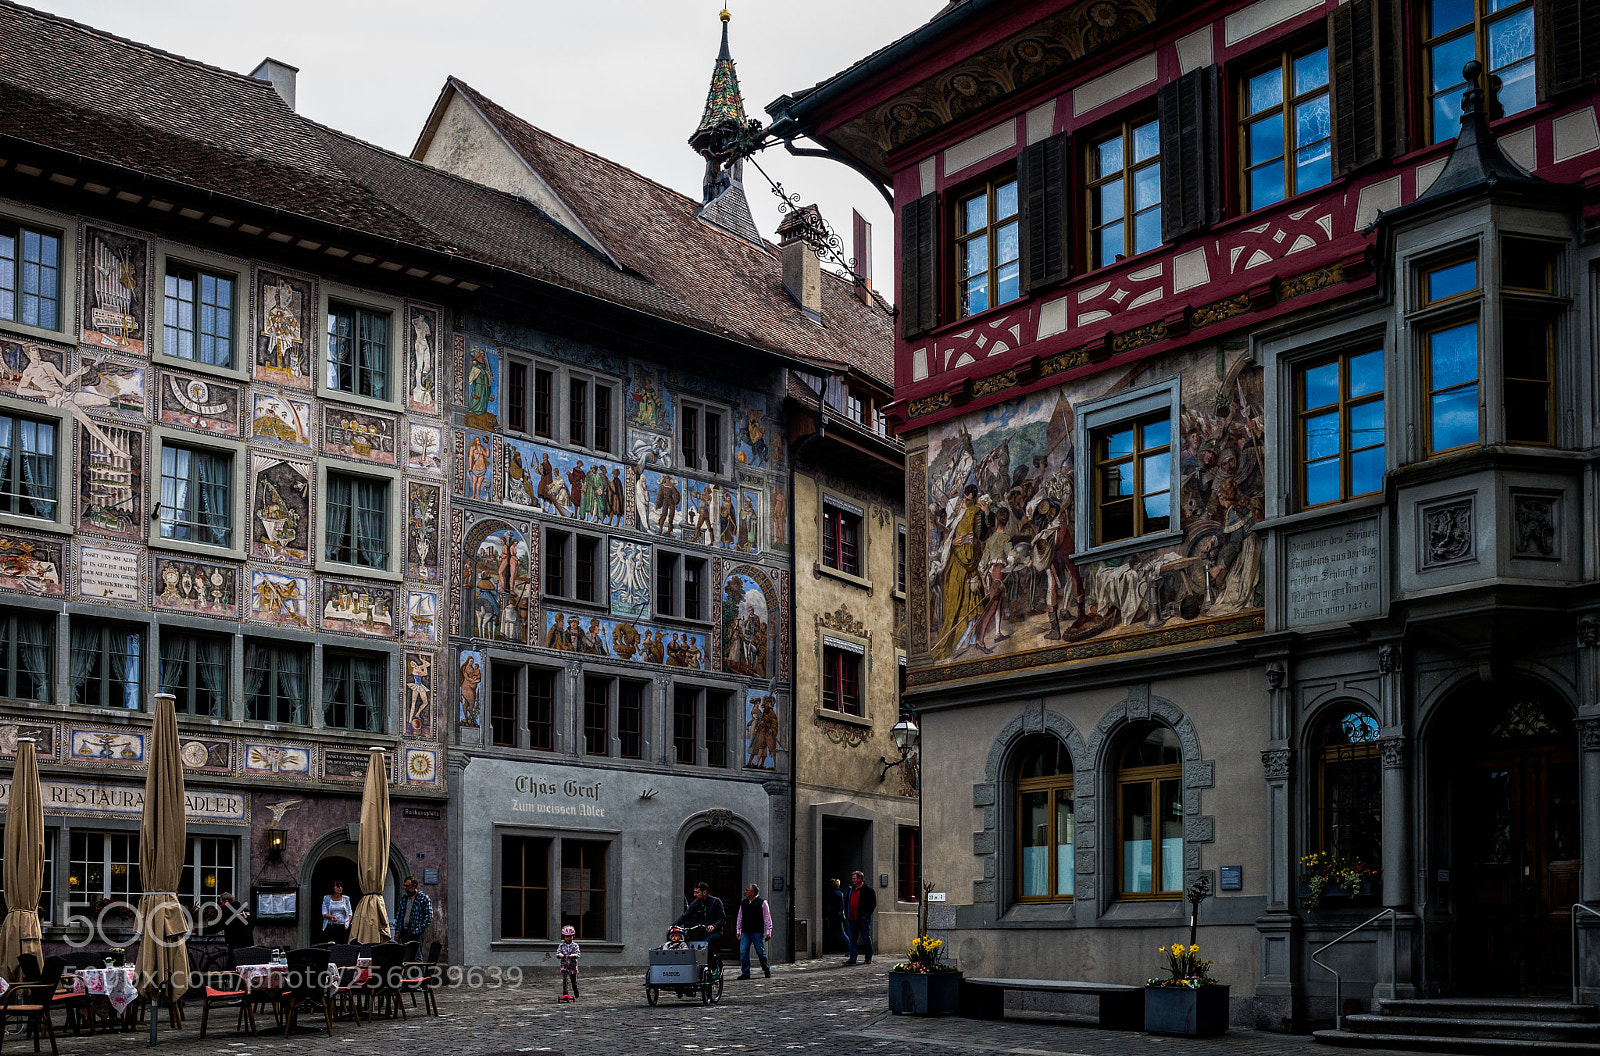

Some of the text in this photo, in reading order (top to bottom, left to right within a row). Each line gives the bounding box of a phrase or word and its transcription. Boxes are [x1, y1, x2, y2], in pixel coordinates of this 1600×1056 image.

[52, 786, 238, 814] RESTAURA ADLER
[563, 780, 601, 801] Graf
[512, 799, 605, 817] Zum weissen Adler
